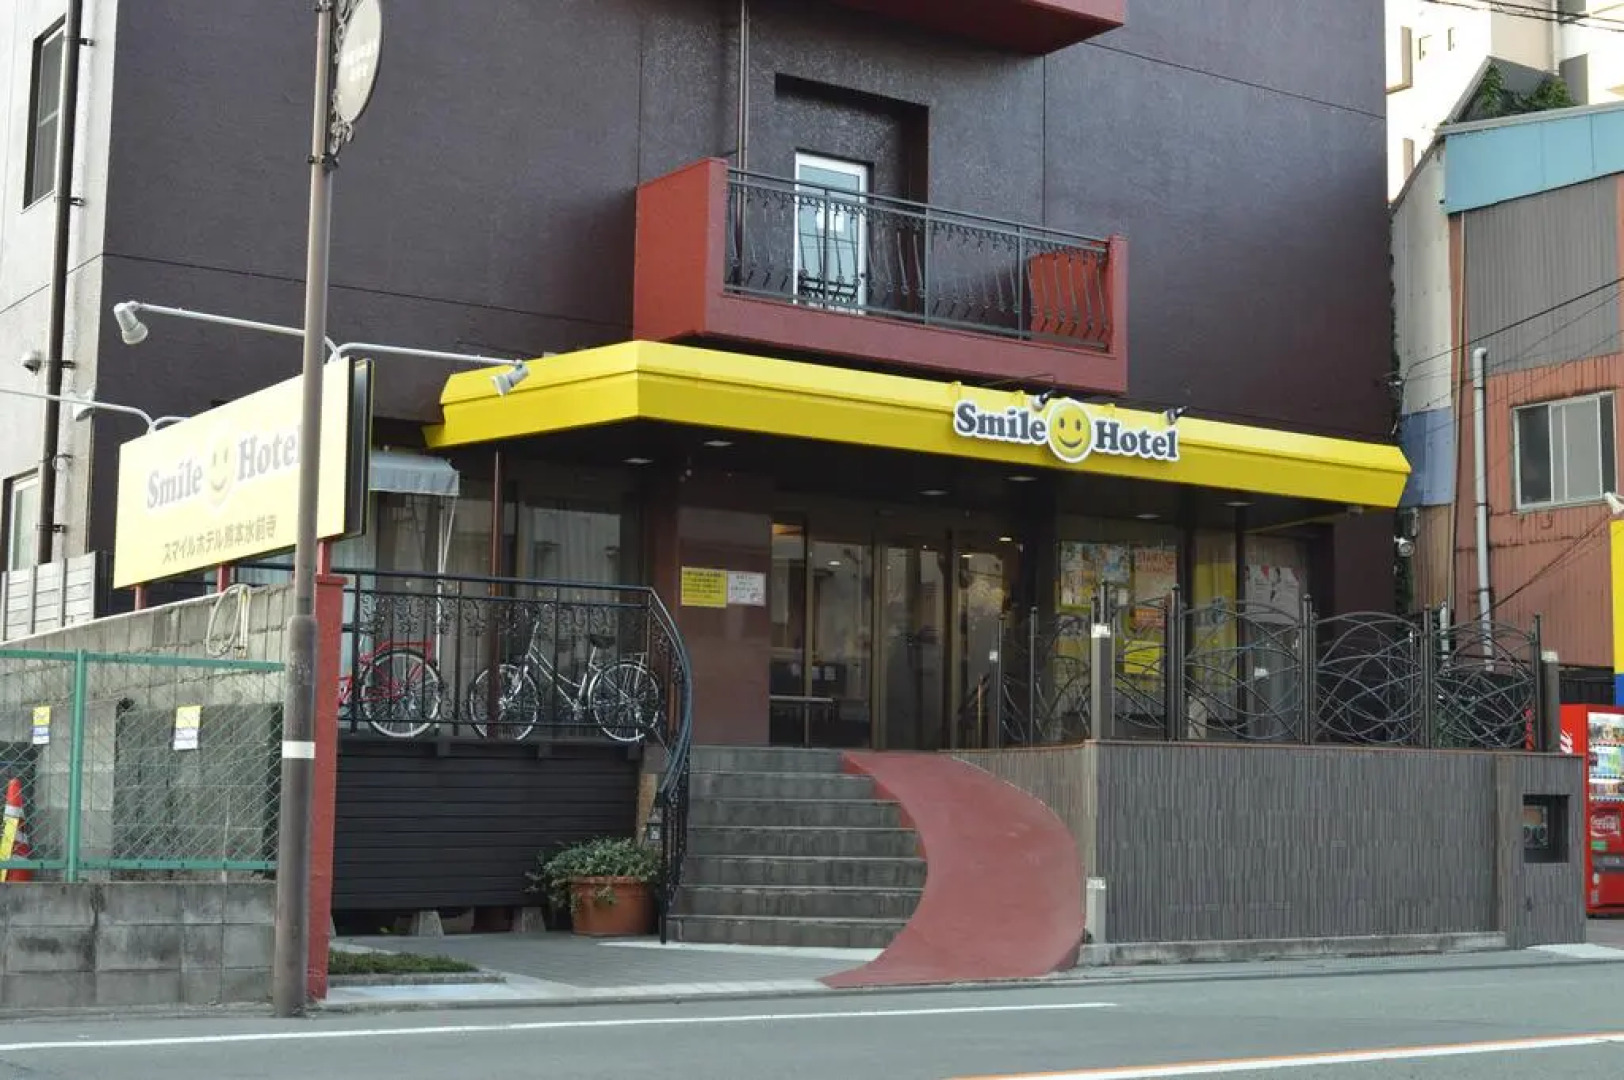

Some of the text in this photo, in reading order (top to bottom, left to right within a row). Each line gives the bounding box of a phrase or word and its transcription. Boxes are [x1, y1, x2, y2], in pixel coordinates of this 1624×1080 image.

[956, 403, 1177, 458] Smile Hotel
[147, 460, 203, 509] Smile
